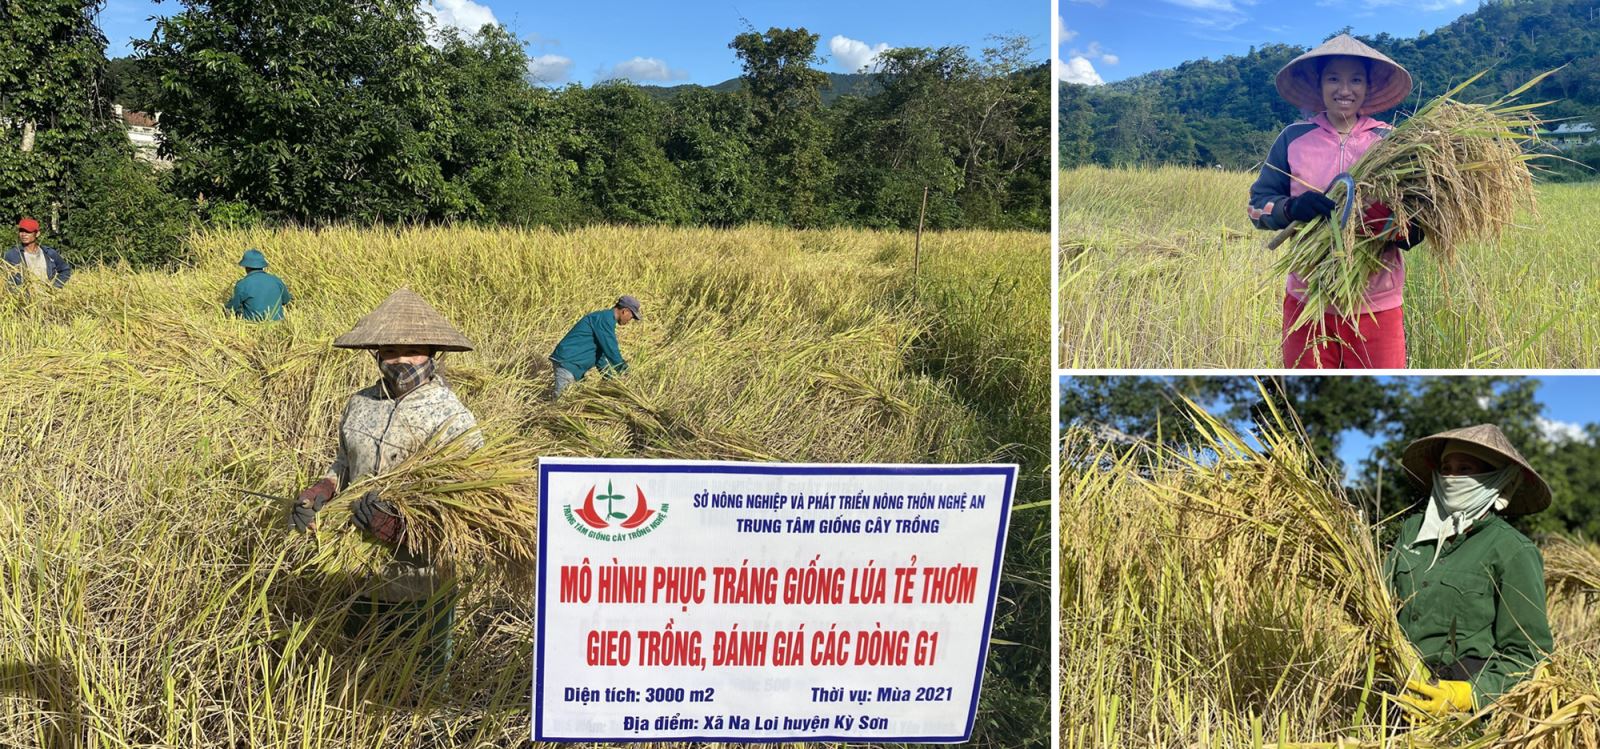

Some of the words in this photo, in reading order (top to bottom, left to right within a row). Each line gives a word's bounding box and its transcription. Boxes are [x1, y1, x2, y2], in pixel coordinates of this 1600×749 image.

[693, 488, 708, 508] SỞ
[711, 492, 742, 508] NÔNG
[746, 492, 788, 512] NGHIỆP
[790, 492, 804, 510] VÀ
[808, 492, 836, 510] PHÁT
[839, 490, 870, 510] TRIỂN
[872, 492, 904, 510] NÔNG
[906, 492, 935, 510] THÔN
[938, 492, 966, 512] NGHỆ
[969, 494, 986, 510] AN
[563, 504, 574, 526] TRUNG
[574, 522, 588, 536] TÂM
[612, 534, 626, 542] CÂY
[650, 514, 668, 532] NGHỆ
[662, 503, 670, 514] AN
[736, 518, 782, 534] TRUNG
[786, 517, 815, 534] TÂM
[819, 514, 861, 534] GIỐNG
[865, 517, 892, 533] CÂY
[896, 514, 940, 533] TRỒNG
[560, 558, 592, 604] MÔ
[598, 558, 647, 604] HÌNH
[652, 566, 706, 612] PHỤC
[712, 559, 778, 604] TRÁNG
[784, 554, 845, 604] GIỐNG
[850, 560, 886, 604] LÚA
[894, 555, 918, 604] TẺ
[922, 564, 978, 604] THƠM
[587, 630, 632, 666] GIEO
[638, 618, 706, 671] TRỒNG,
[712, 624, 768, 666] ĐÁNH
[772, 624, 804, 666] GIÁ
[810, 624, 850, 666] CÁC
[854, 622, 910, 666] DÒNG
[914, 630, 938, 666] G1
[564, 687, 600, 706] Diện
[605, 687, 640, 702] tích:
[645, 688, 684, 702] 3000
[690, 688, 714, 702] m2
[811, 687, 844, 702] Thời
[850, 689, 872, 705] vụ:
[877, 687, 910, 702] Mùa
[915, 687, 952, 701] 2021
[624, 716, 650, 734] Địa
[654, 712, 698, 730] điểm:
[702, 716, 724, 730] Xã
[728, 716, 750, 730] Na
[754, 716, 779, 730] Loi
[783, 715, 829, 732] huyện
[834, 714, 854, 730] Kỳ
[858, 716, 888, 730] Sơn
